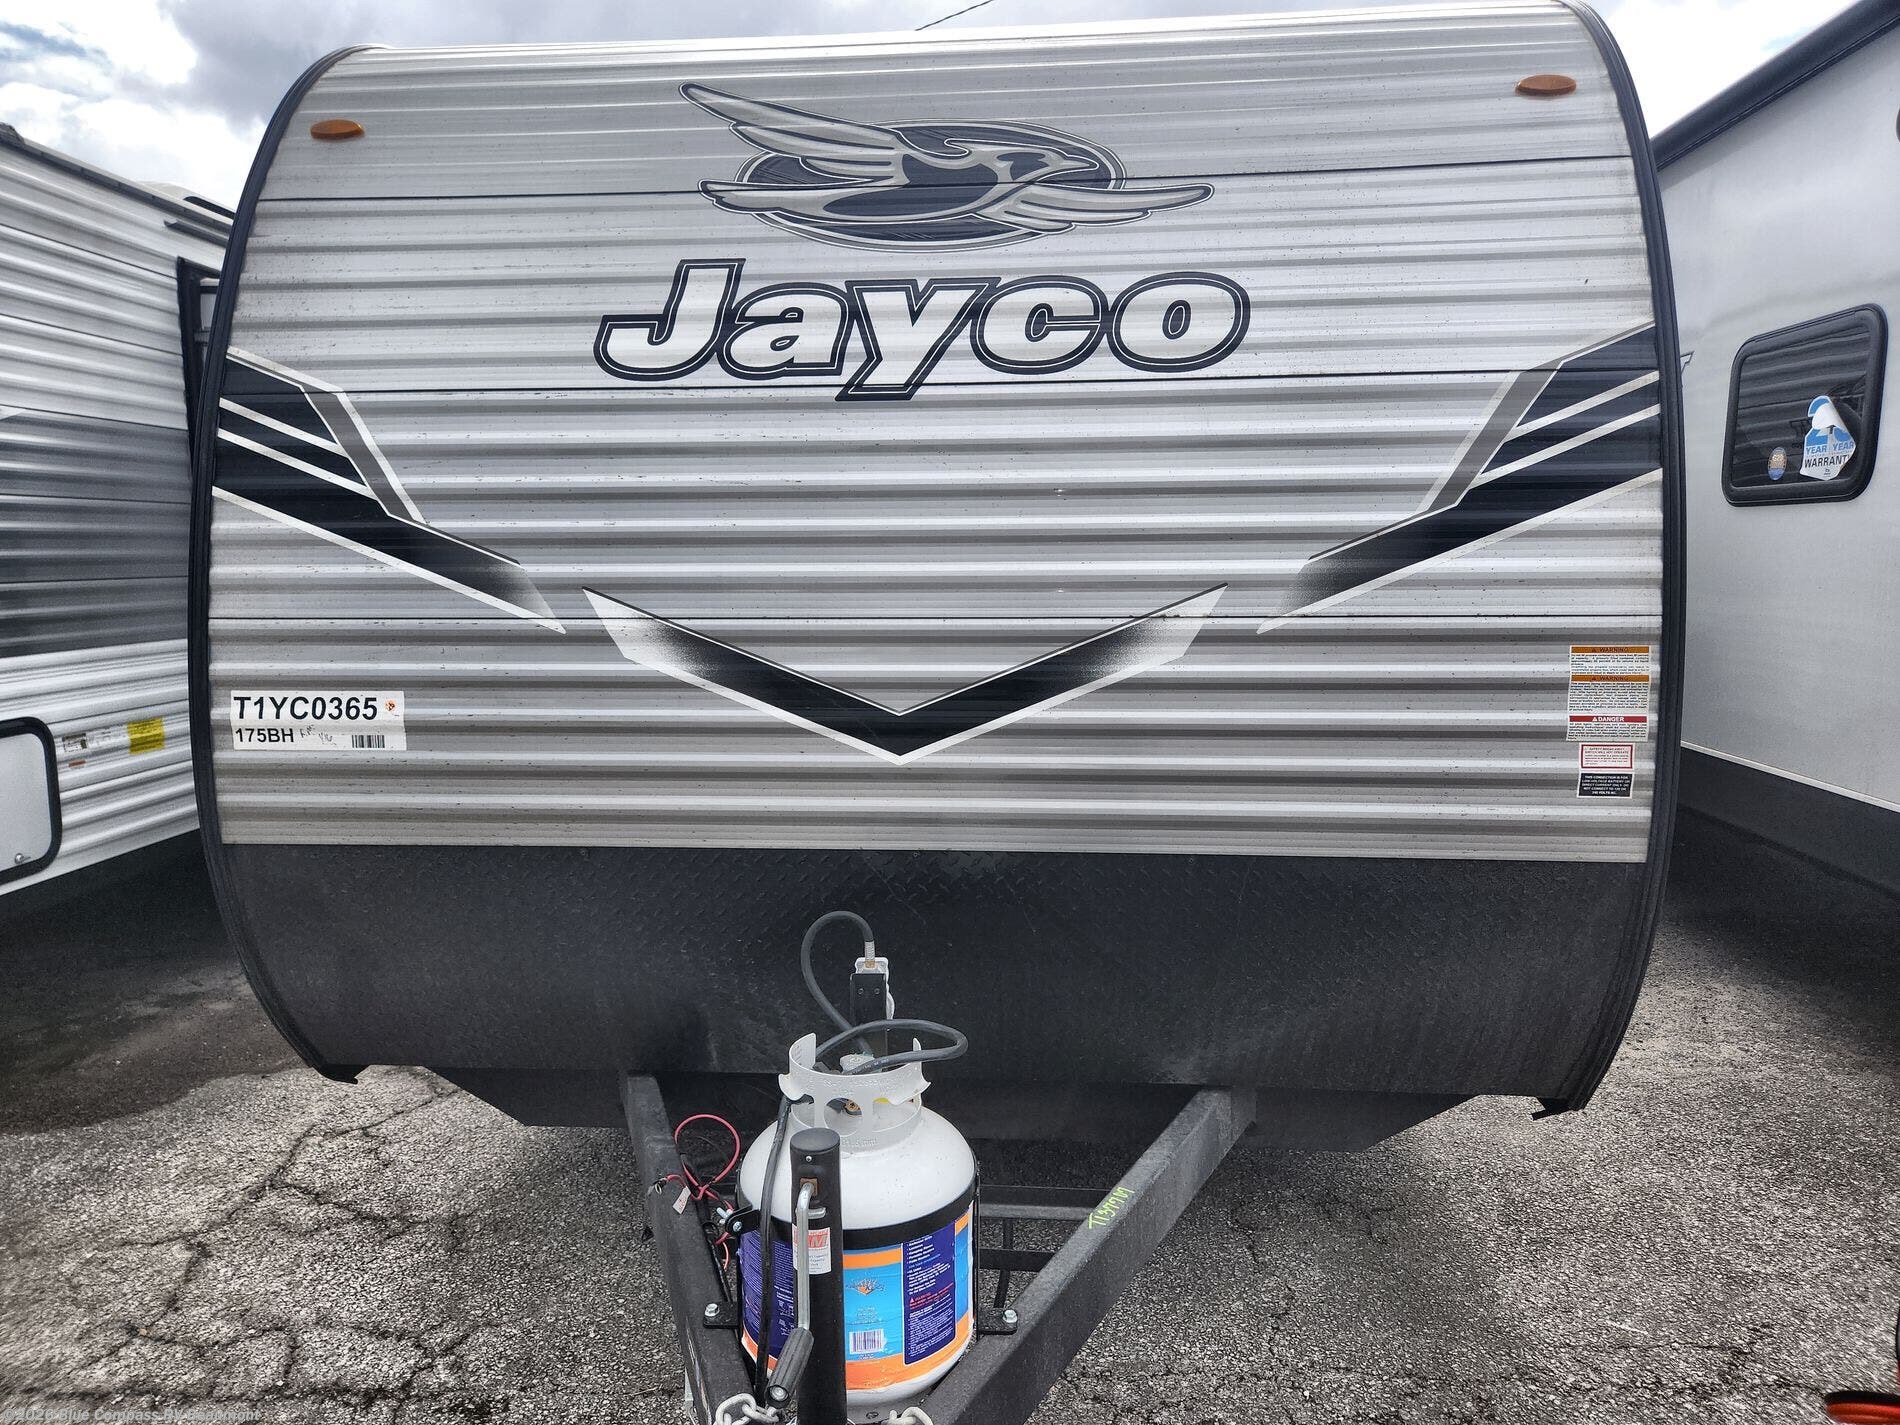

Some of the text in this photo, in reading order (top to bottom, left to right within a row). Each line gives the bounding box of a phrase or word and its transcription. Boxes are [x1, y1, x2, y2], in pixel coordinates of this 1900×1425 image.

[593, 257, 1251, 401] Jayco
[1806, 445, 1827, 455] YEAR
[1804, 454, 1850, 468] WARRANT
[233, 696, 378, 720] T1YC0365
[235, 727, 294, 743] 175BH
